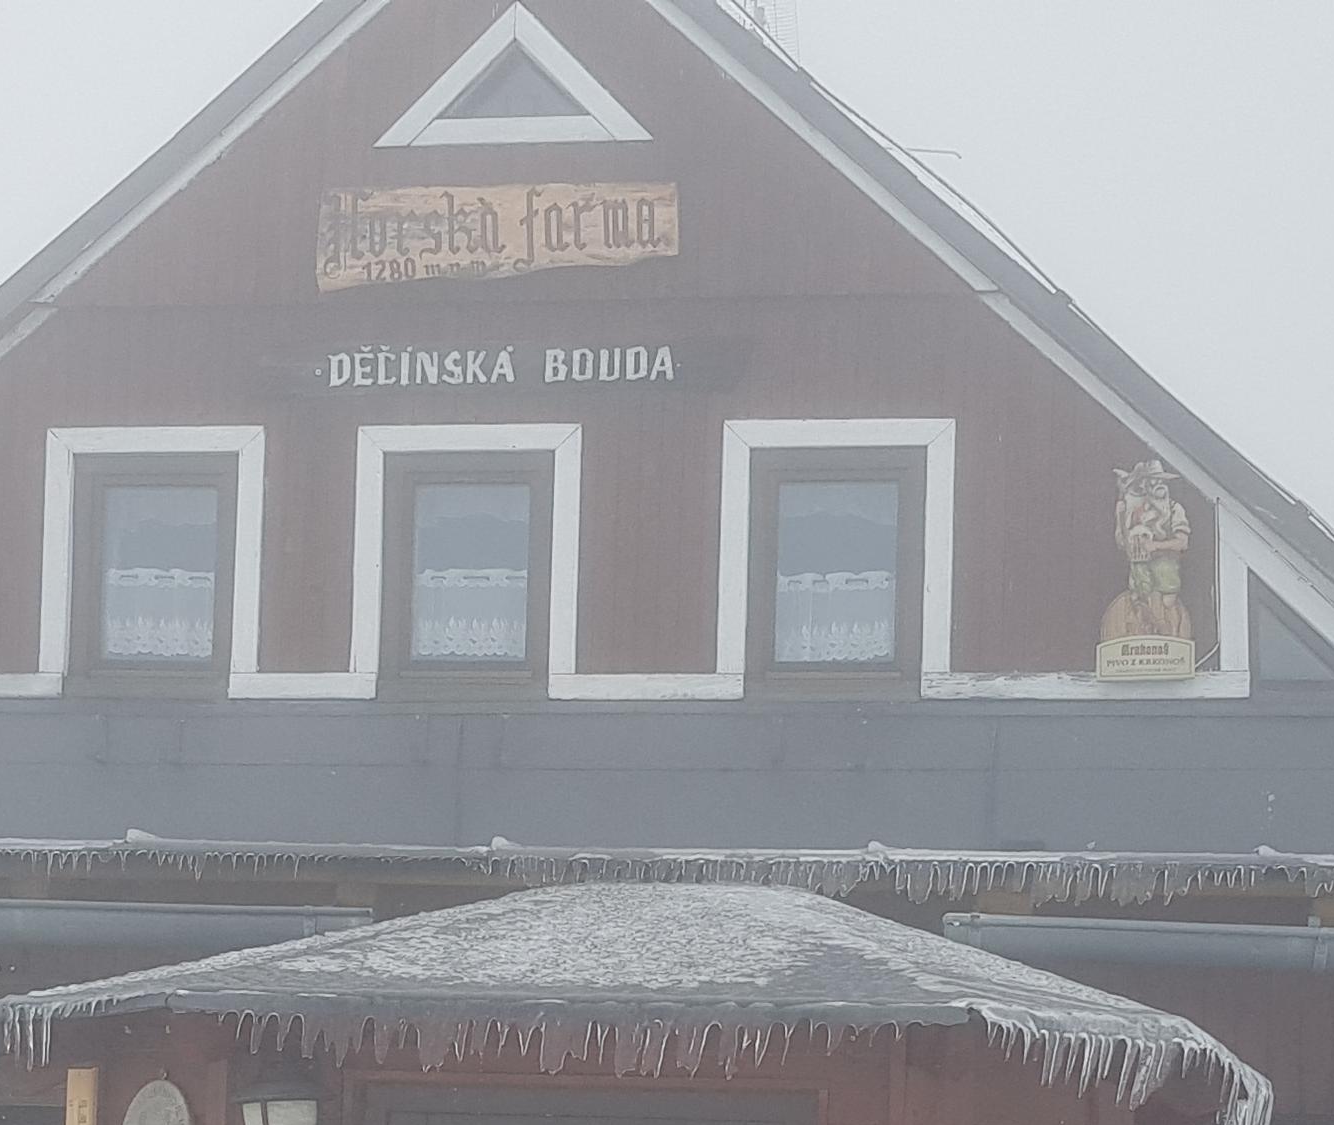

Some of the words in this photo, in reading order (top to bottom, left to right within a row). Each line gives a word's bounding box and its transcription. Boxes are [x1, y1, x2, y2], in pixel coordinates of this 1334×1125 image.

[363, 258, 416, 281] 1280
[329, 346, 516, 387] DĚČÍNSKÁ
[545, 346, 674, 382] BOUDA
[1107, 659, 1129, 667] PIVO
